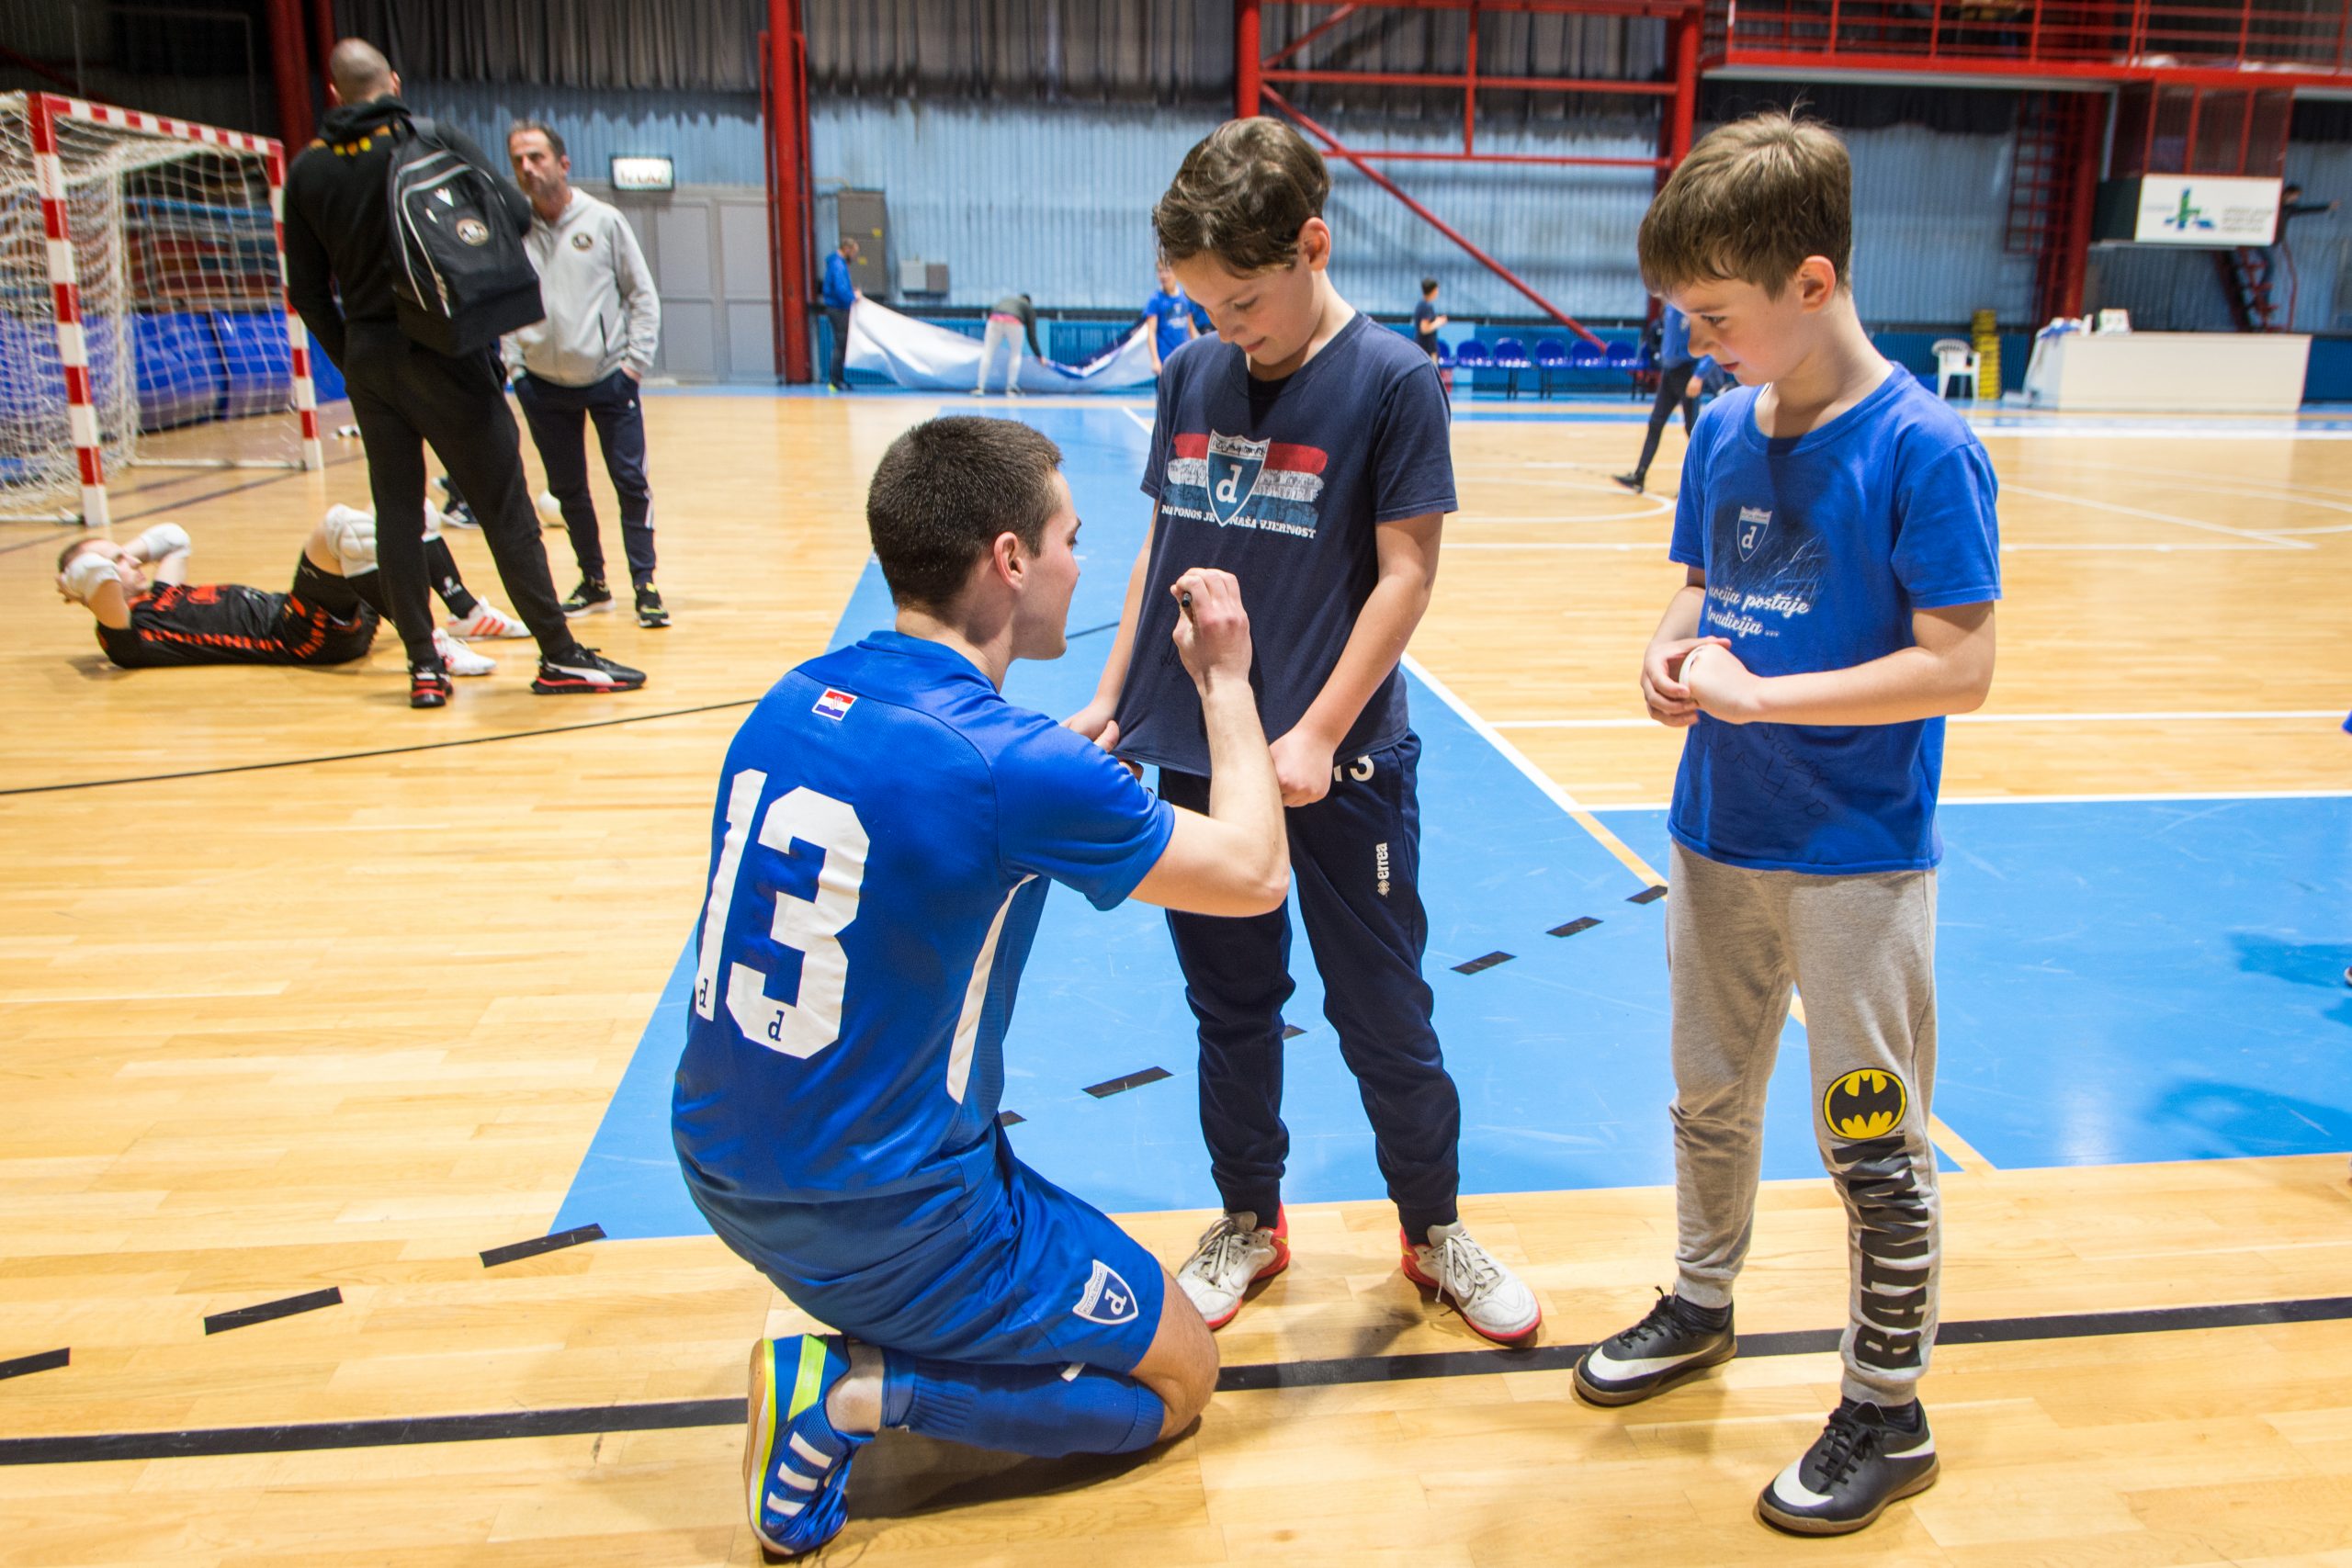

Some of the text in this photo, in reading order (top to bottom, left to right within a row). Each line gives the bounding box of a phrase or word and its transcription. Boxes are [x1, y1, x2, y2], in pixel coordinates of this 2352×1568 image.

[1216, 464, 1242, 503] d
[1229, 514, 1257, 529] NAŠA
[1260, 519, 1317, 539] VJERNOST
[1741, 525, 1757, 549] d
[1707, 604, 1762, 637] tradicija
[1742, 593, 1809, 618] postaje
[695, 768, 870, 1060] 13
[767, 1010, 786, 1042] d
[1831, 1135, 1929, 1370] BATMAN
[1104, 1288, 1127, 1314] d
